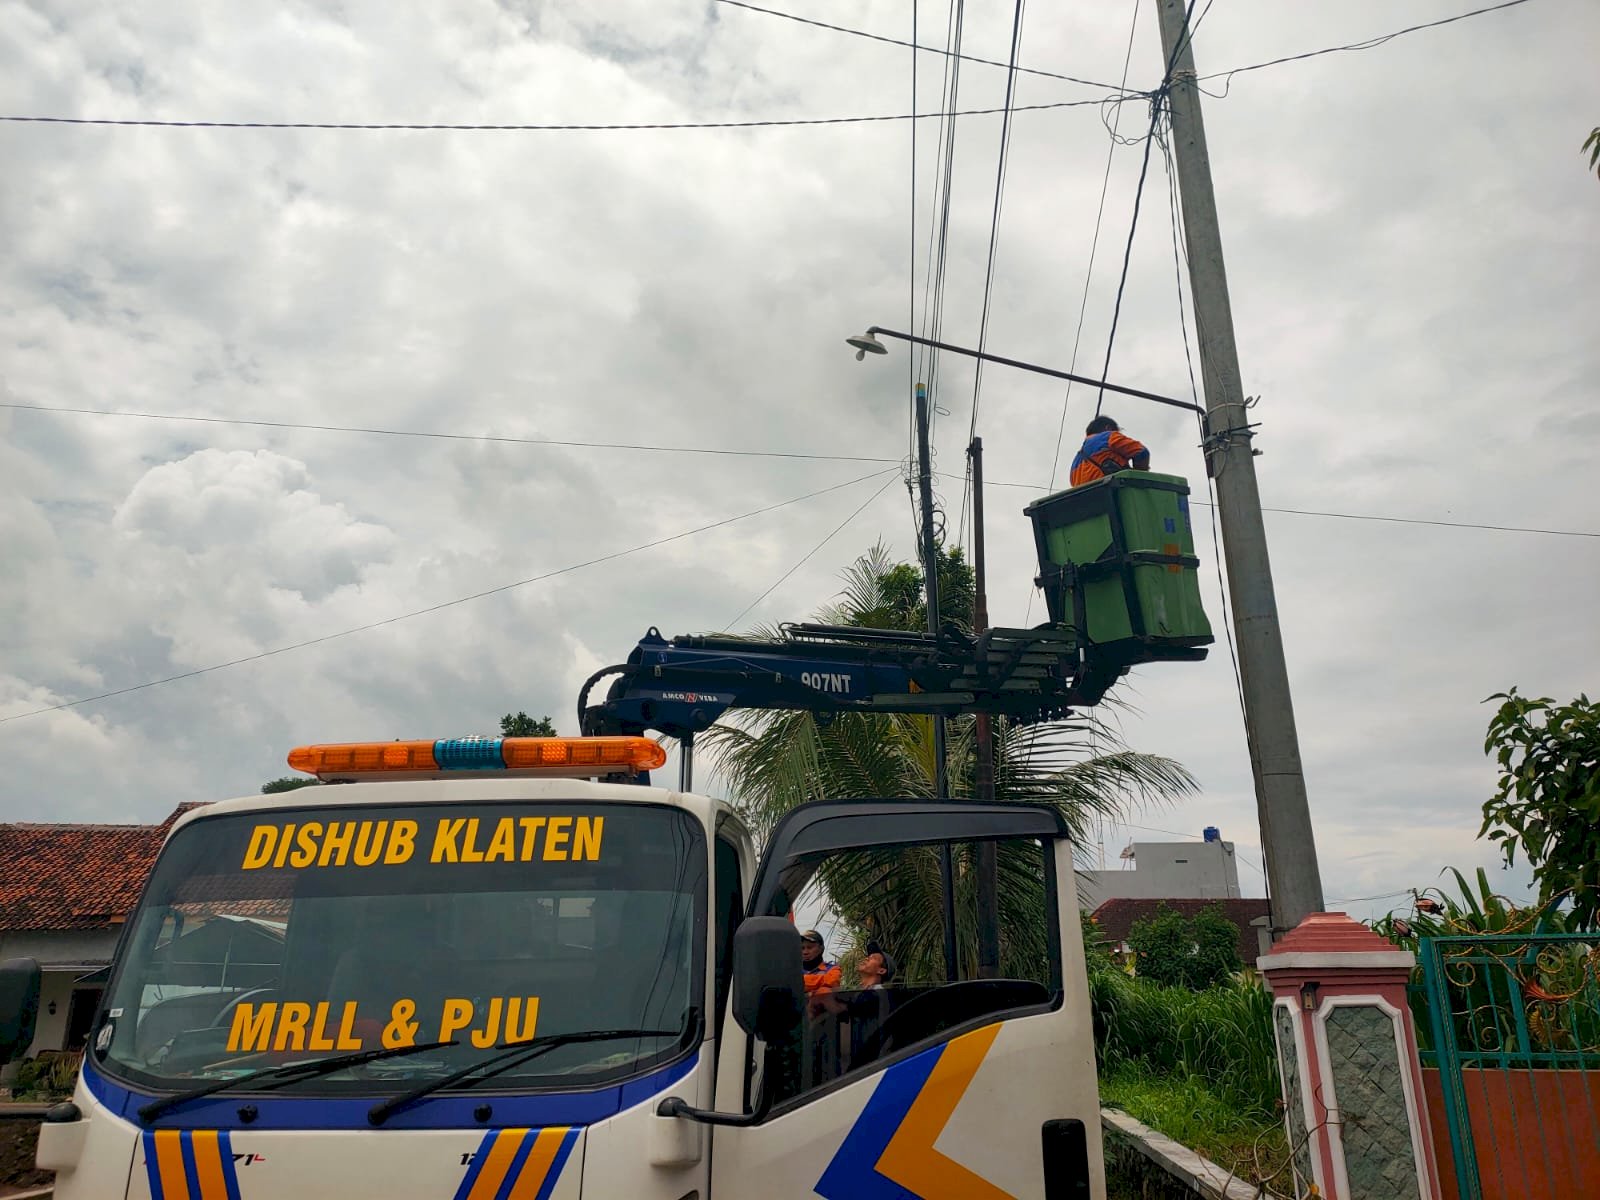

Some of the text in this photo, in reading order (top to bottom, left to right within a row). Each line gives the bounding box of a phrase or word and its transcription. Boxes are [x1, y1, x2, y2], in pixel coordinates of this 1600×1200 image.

[801, 671, 852, 694] 907NT
[242, 816, 604, 870] DISHUB KLATEN
[226, 997, 540, 1051] MRLL & PJU
